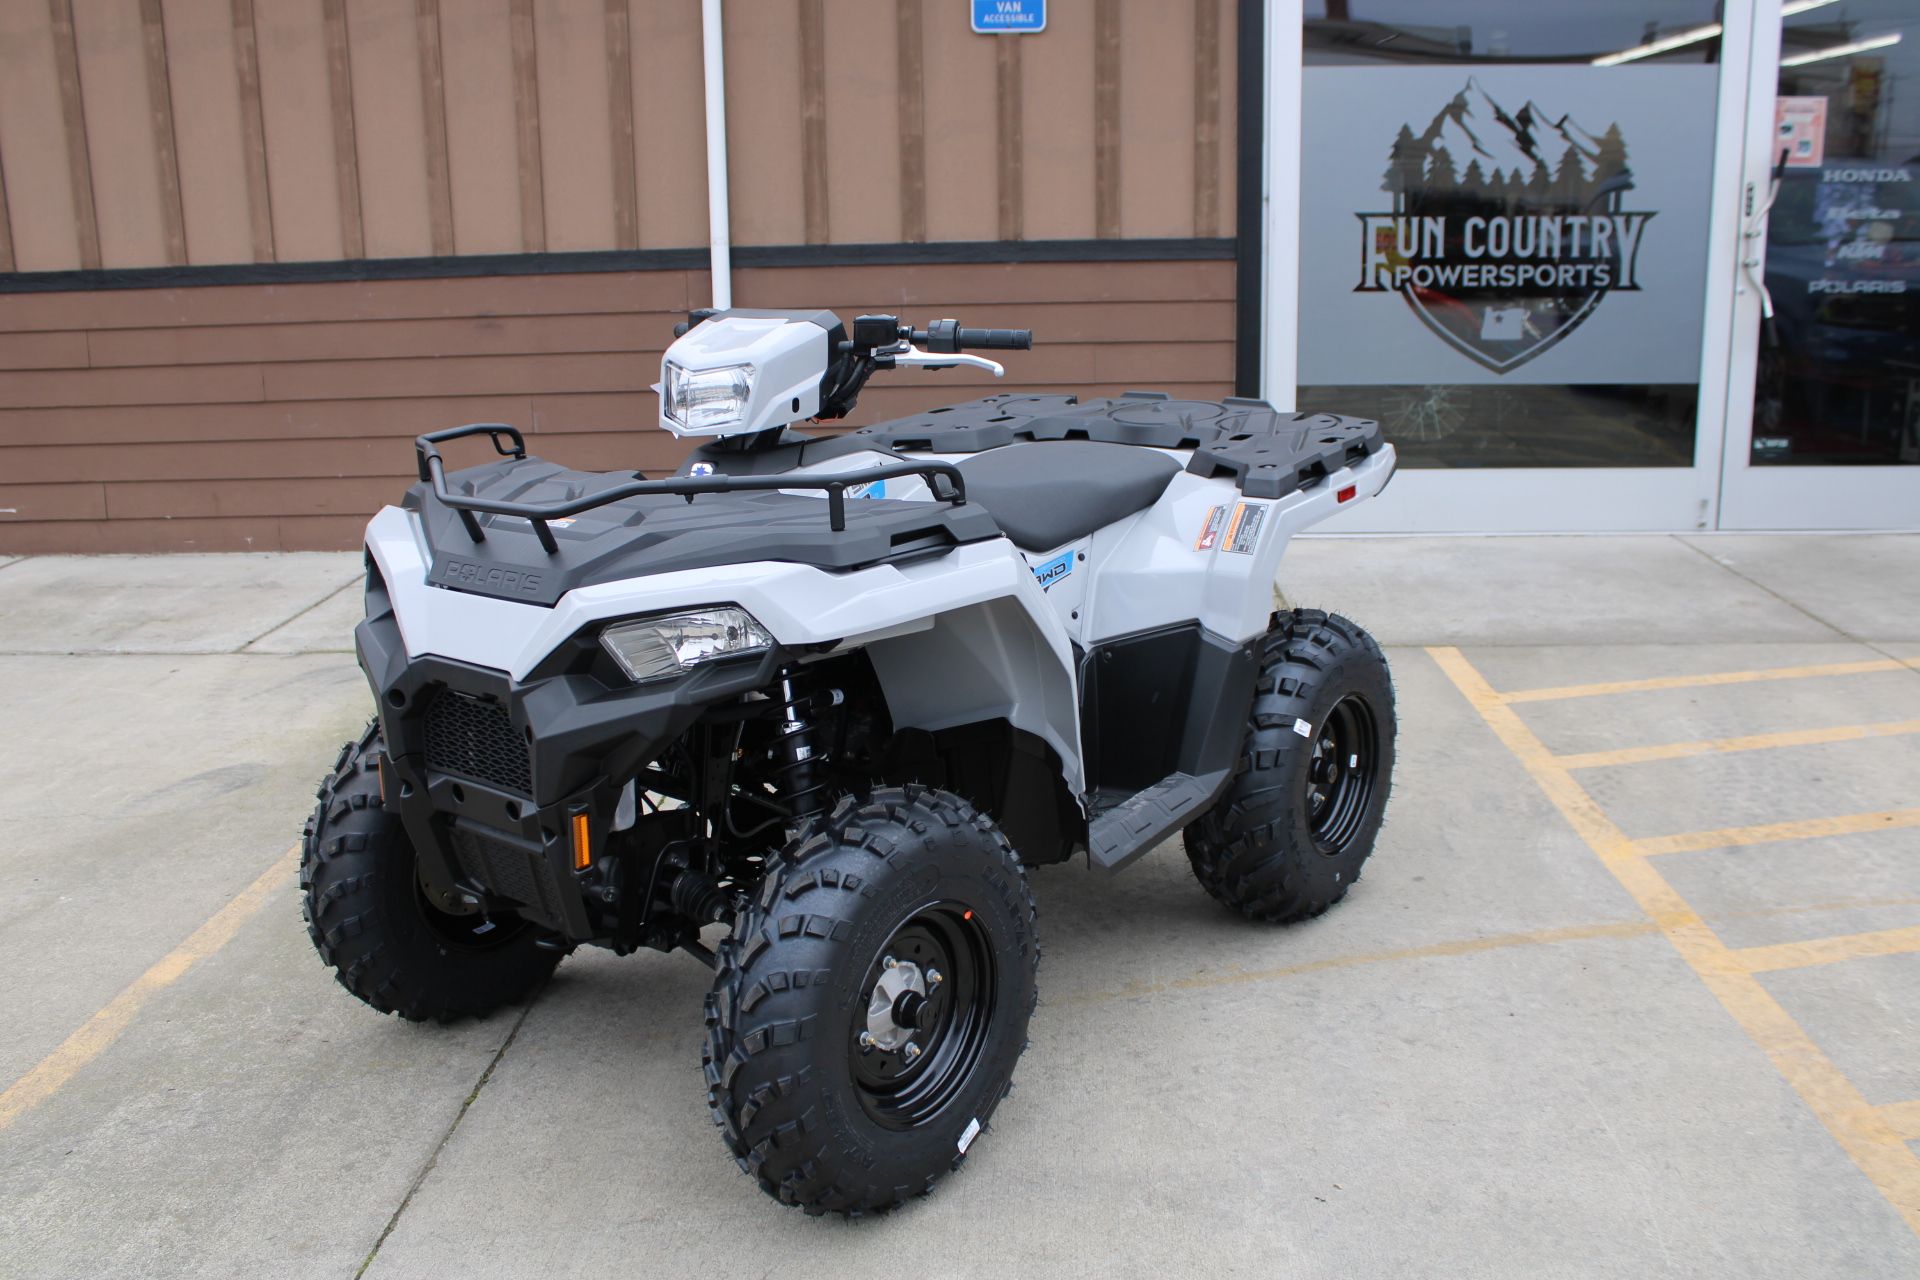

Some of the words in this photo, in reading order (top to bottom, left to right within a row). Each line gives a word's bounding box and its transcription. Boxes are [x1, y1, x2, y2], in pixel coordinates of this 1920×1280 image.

[996, 1, 1022, 13] VAN
[983, 13, 1035, 24] ACCESSIBLE
[1823, 169, 1912, 183] HONDA
[1364, 215, 1446, 289] FUN
[1463, 215, 1646, 288] COUNTRY
[1394, 263, 1611, 288] POWERSPORTS
[1807, 279, 1906, 294] POLARIS
[444, 560, 544, 594] POLARIS
